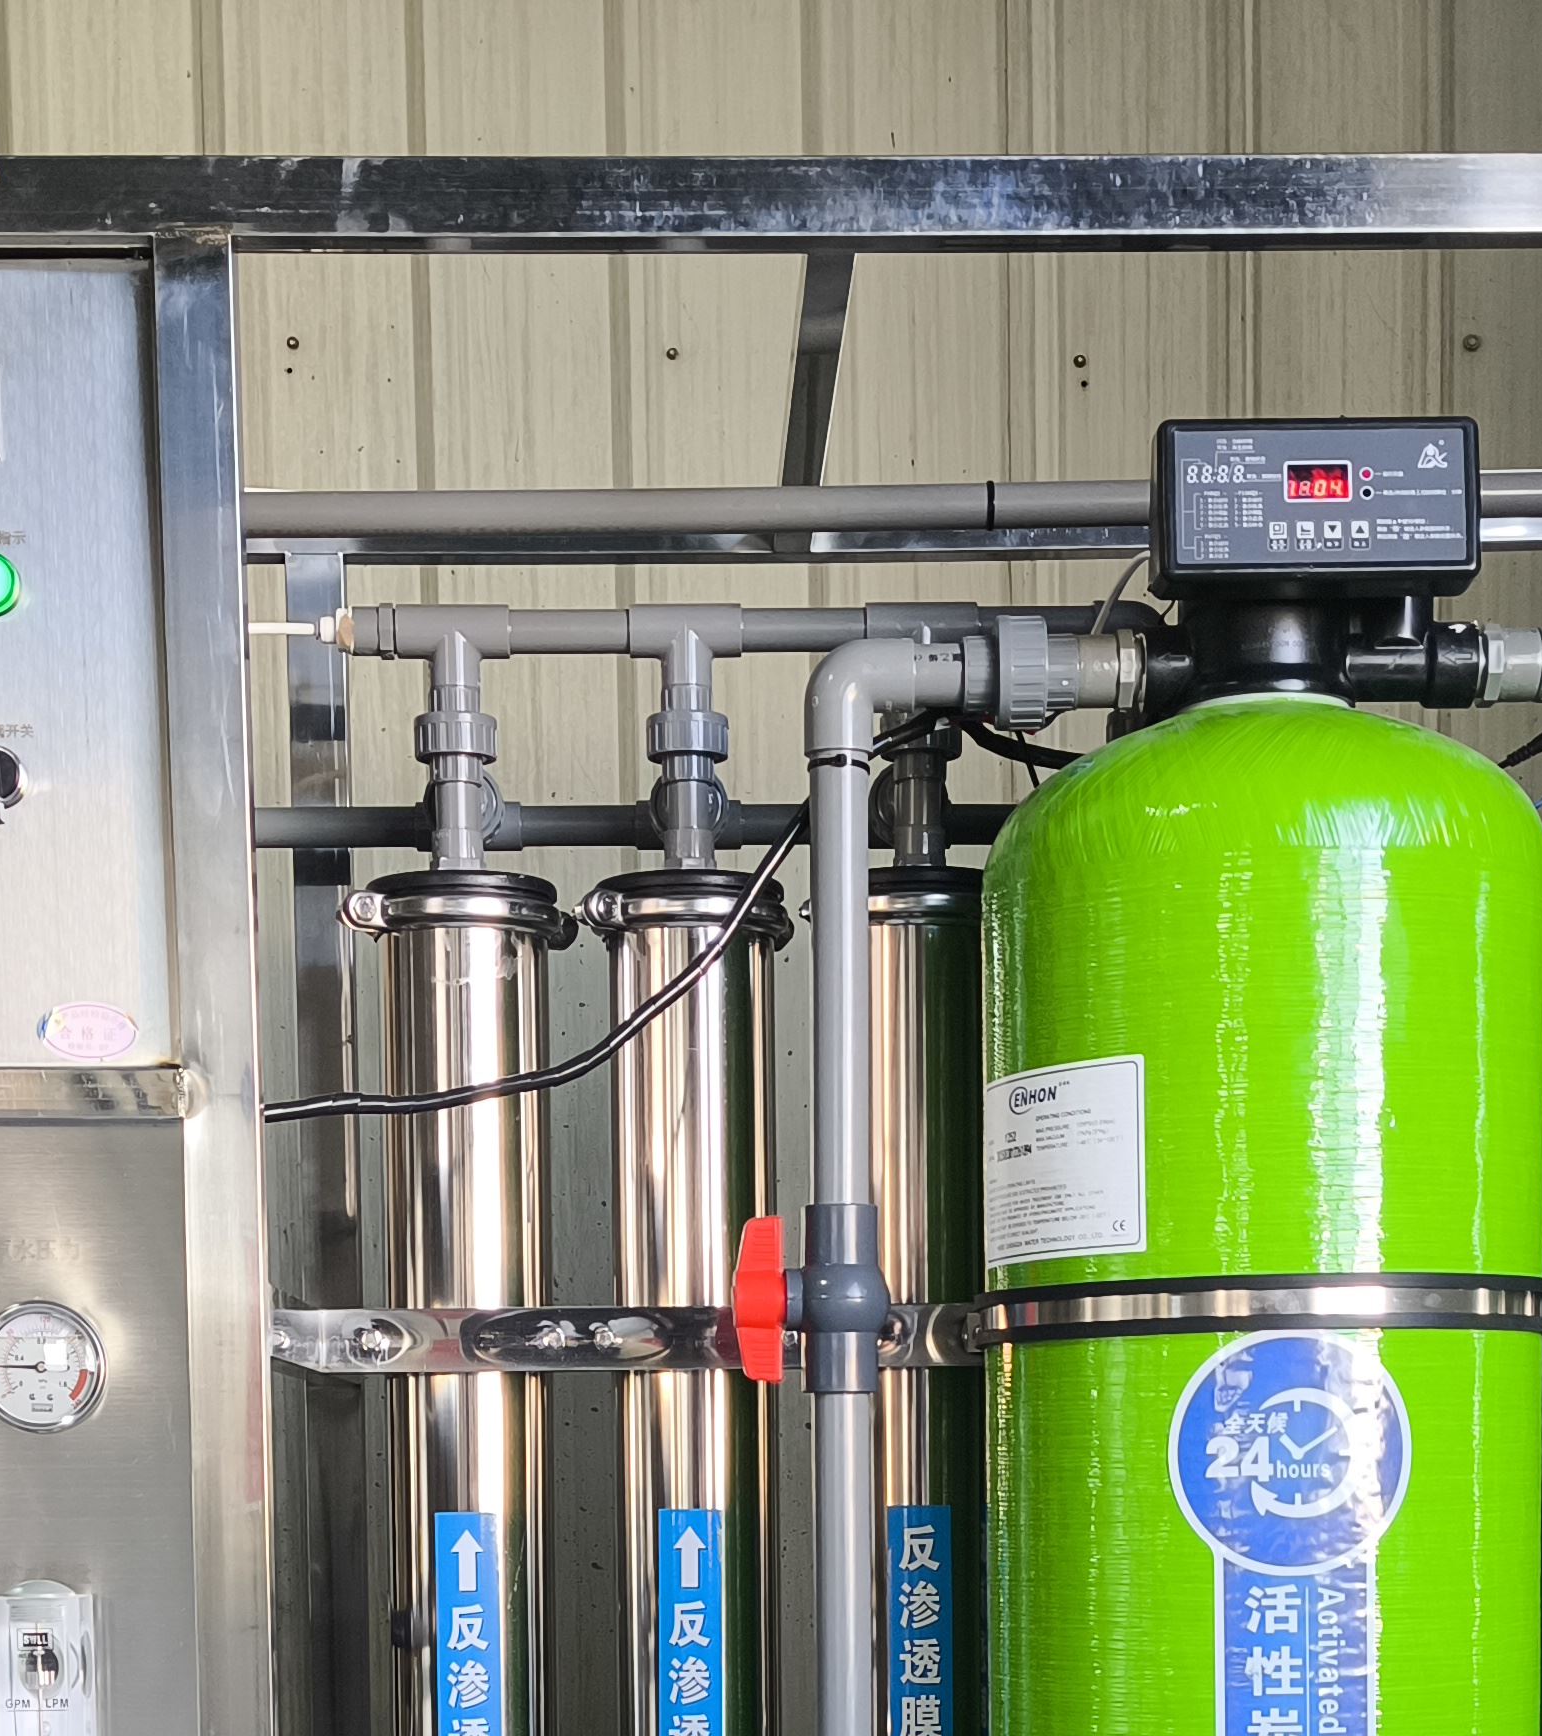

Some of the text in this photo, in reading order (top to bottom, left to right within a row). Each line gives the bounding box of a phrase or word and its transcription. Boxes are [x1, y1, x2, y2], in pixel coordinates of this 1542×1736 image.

[1222, 1410, 1289, 1434] 全天候
[1205, 1435, 1331, 1482] 24 hours
[1317, 1586, 1347, 1734] Activated
[5, 1698, 69, 1709] GPM LPM
